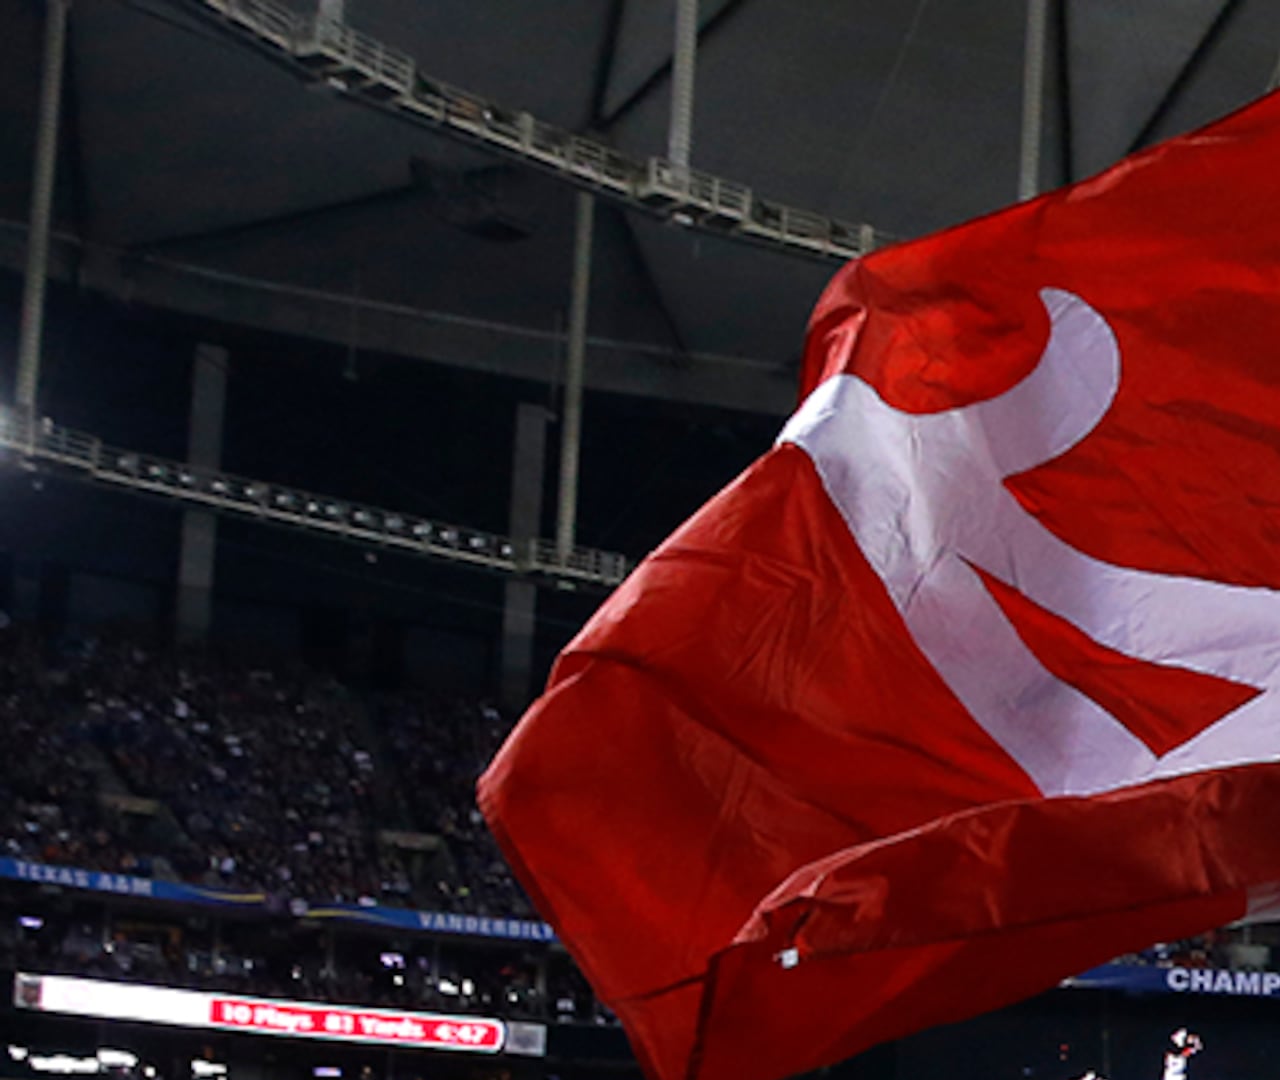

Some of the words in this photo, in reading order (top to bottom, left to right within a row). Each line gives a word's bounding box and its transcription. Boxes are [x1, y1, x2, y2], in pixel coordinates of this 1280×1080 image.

[15, 861, 89, 888] TEXAS
[96, 873, 151, 896] A&M
[222, 1004, 250, 1022] 10
[254, 1007, 314, 1032] Plays
[360, 1017, 424, 1039] Yards
[435, 1024, 487, 1044] 4:47
